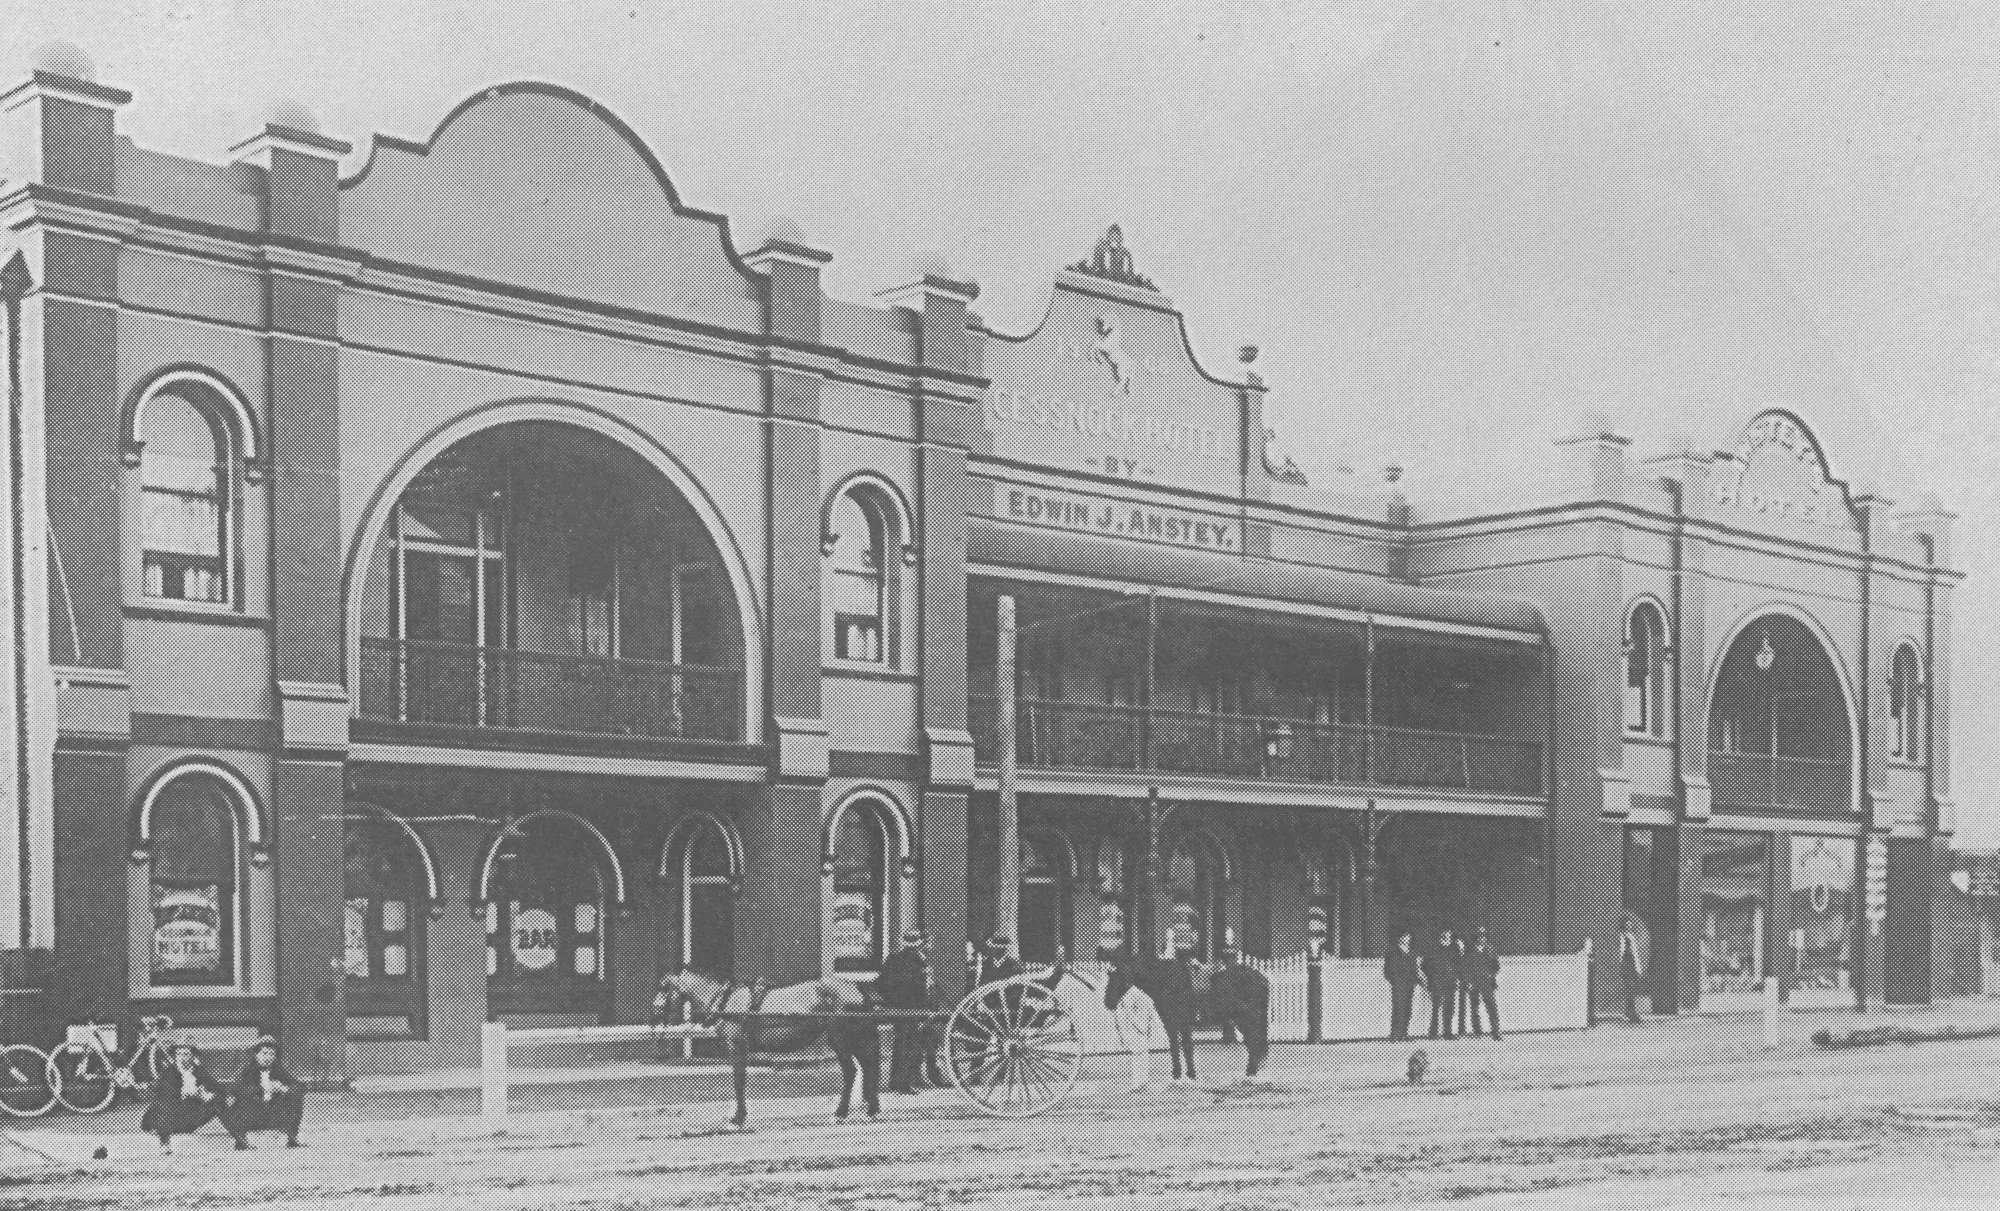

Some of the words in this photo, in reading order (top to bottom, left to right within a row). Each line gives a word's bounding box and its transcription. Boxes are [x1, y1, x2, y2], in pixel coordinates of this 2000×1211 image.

[993, 386, 1142, 443] CESSNOCK
[1145, 415, 1230, 463] HOTEL
[1008, 490, 1090, 525] EDWIN
[516, 928, 557, 950] BAR
